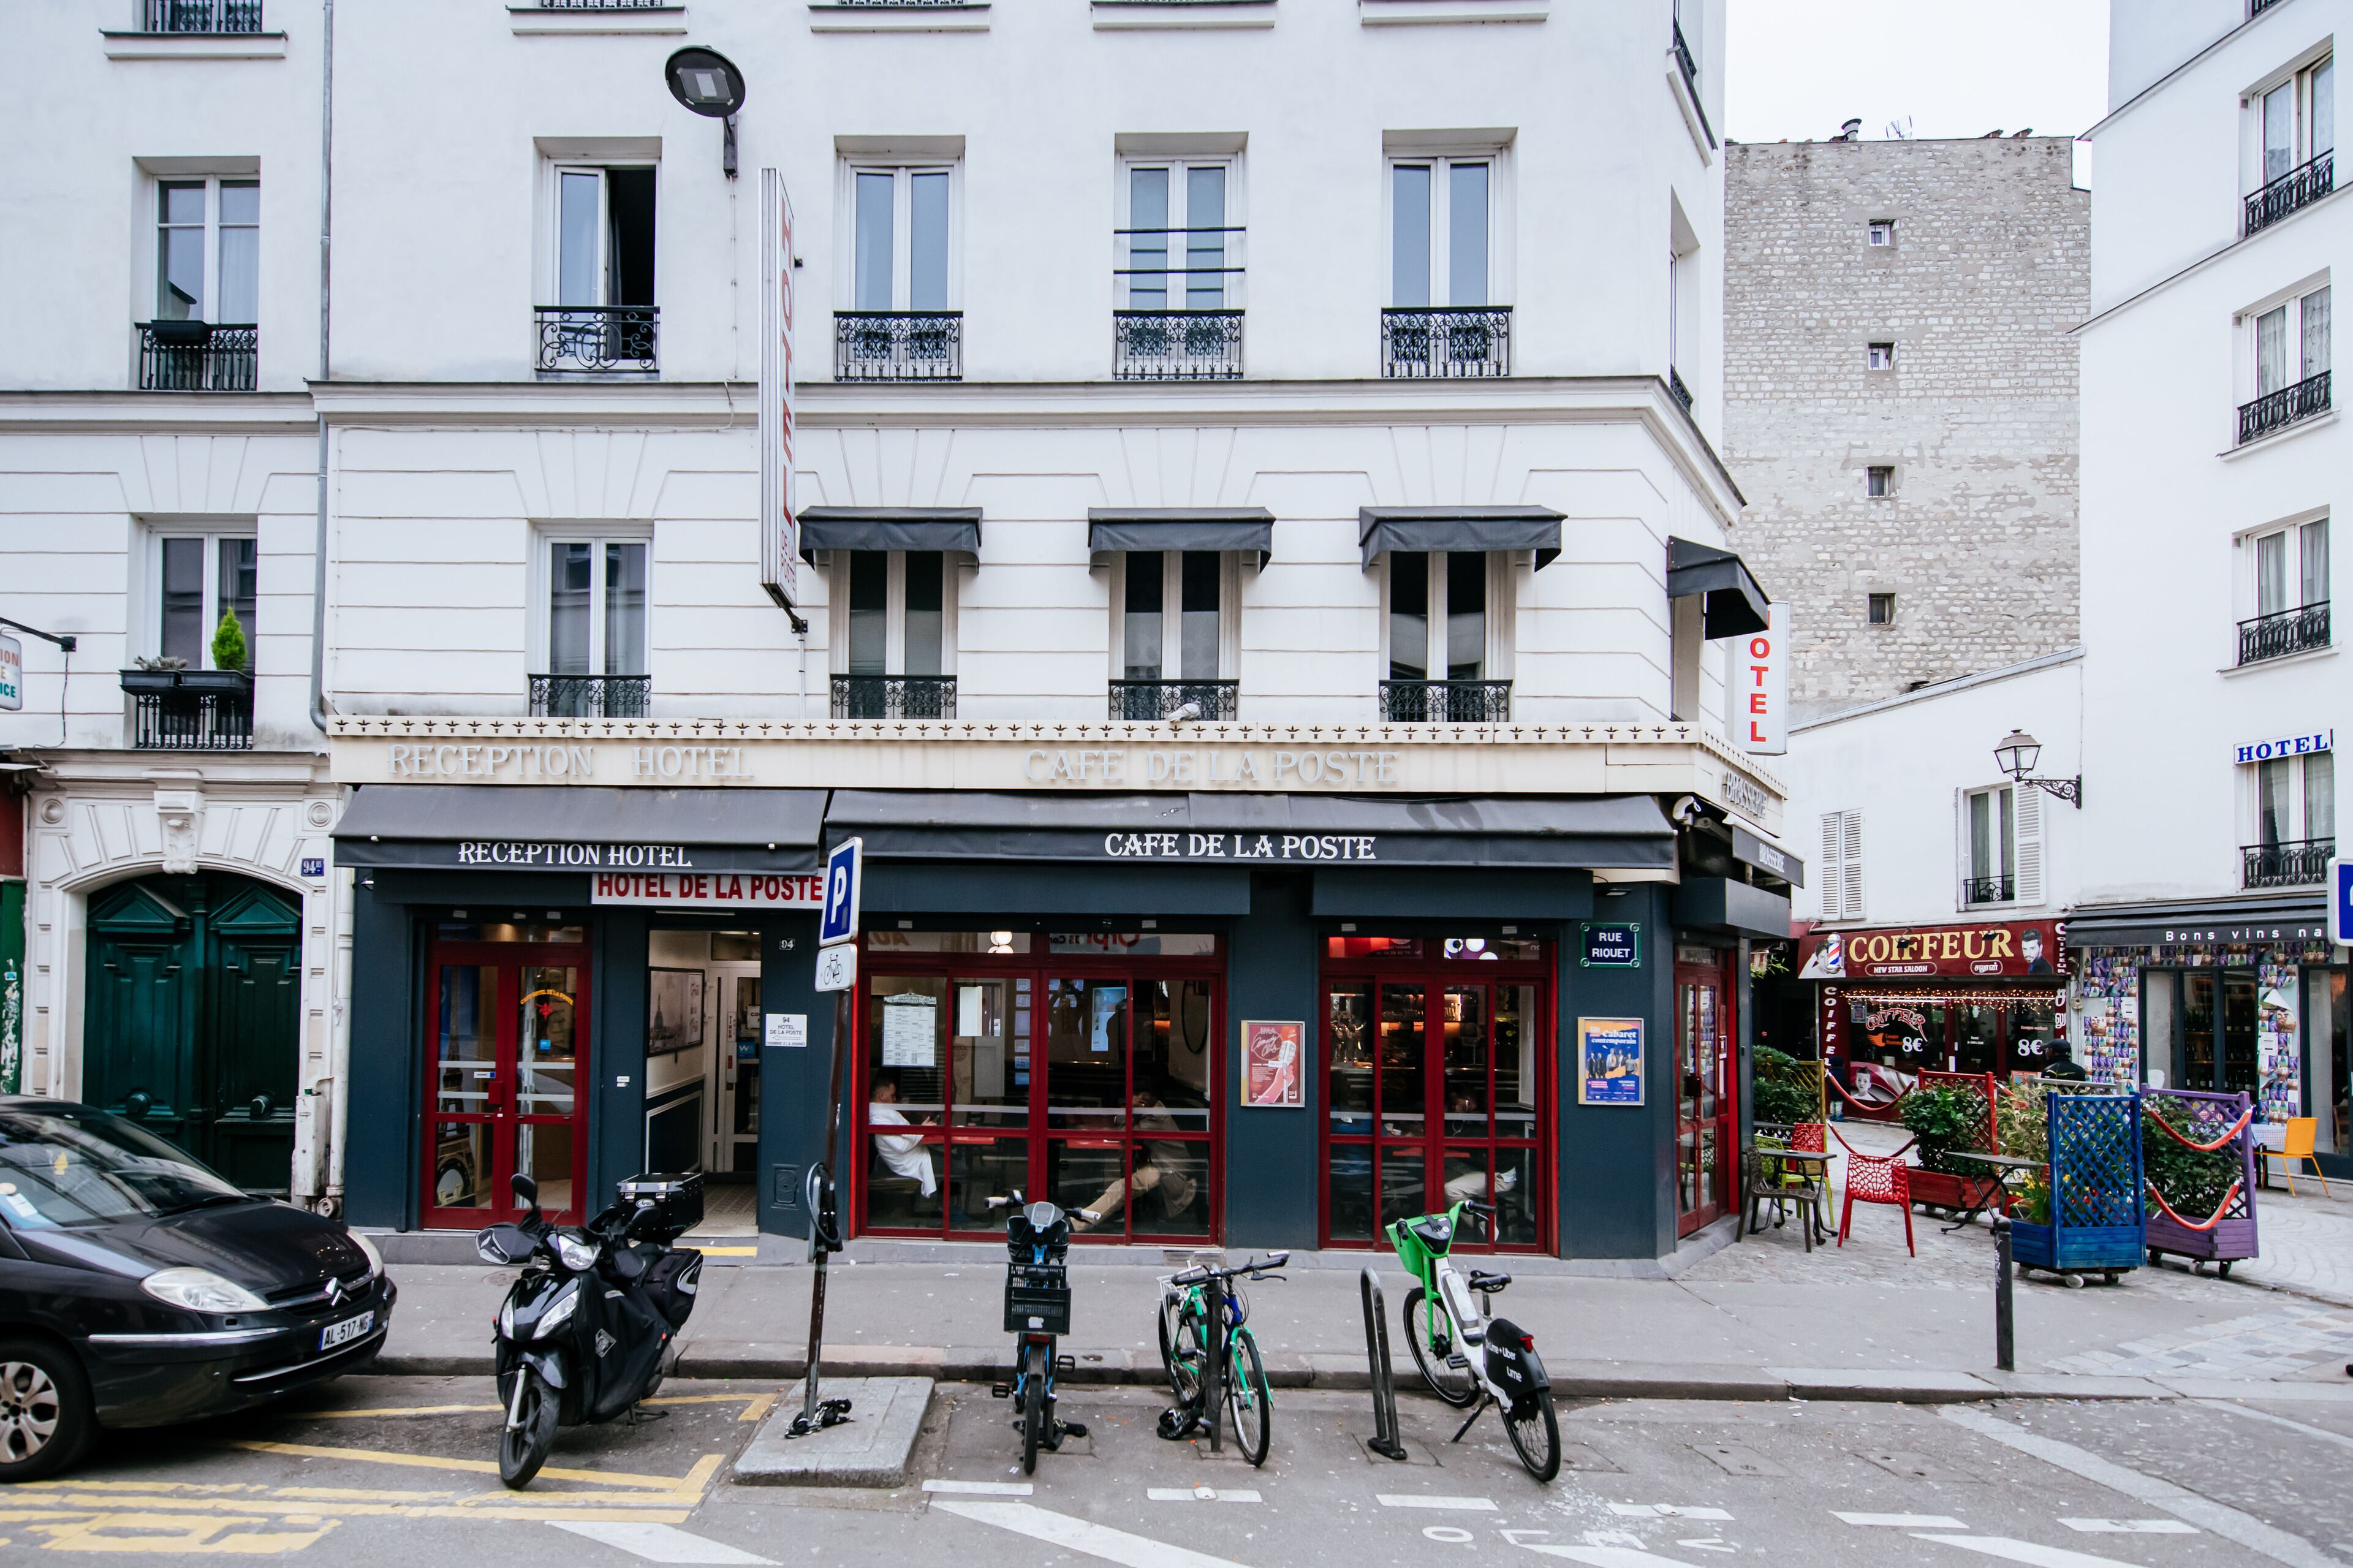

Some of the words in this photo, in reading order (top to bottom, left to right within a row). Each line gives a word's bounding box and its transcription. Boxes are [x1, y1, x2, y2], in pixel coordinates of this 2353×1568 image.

[781, 197, 792, 528] HOTEL
[1750, 610, 1770, 742] OTEL
[387, 744, 594, 776] RECEPTION
[632, 746, 755, 777] HOTEL
[2237, 735, 2328, 762] HÔTEL
[1023, 749, 1125, 781] CAFE
[1146, 750, 1195, 782] DE
[1209, 751, 1261, 782] LA
[1275, 751, 1399, 783] POSTE
[1726, 771, 1767, 819] BRASSERIE
[458, 842, 600, 865] RECEPTION
[607, 845, 692, 868] HOTEL
[1105, 833, 1180, 857] CAFE
[1188, 834, 1226, 858] DE
[1233, 835, 1275, 858] LA
[1282, 835, 1377, 860] POSTE
[598, 874, 672, 898] HOTEL
[680, 875, 707, 899] DE
[715, 876, 742, 900] LA
[751, 876, 823, 901] POSTE
[830, 866, 847, 924] P
[781, 939, 794, 949] 94
[1599, 932, 1623, 942] RUE
[1849, 929, 2015, 963] COIFFEUR
[2165, 931, 2215, 941] Bons
[2232, 928, 2279, 939] vins
[1592, 948, 1631, 958] RIQUET
[1602, 1029, 1637, 1038] Cabaret
[1902, 1037, 1923, 1053] 8€
[2018, 1039, 2043, 1056] 8€
[1502, 1347, 1516, 1360] Uber
